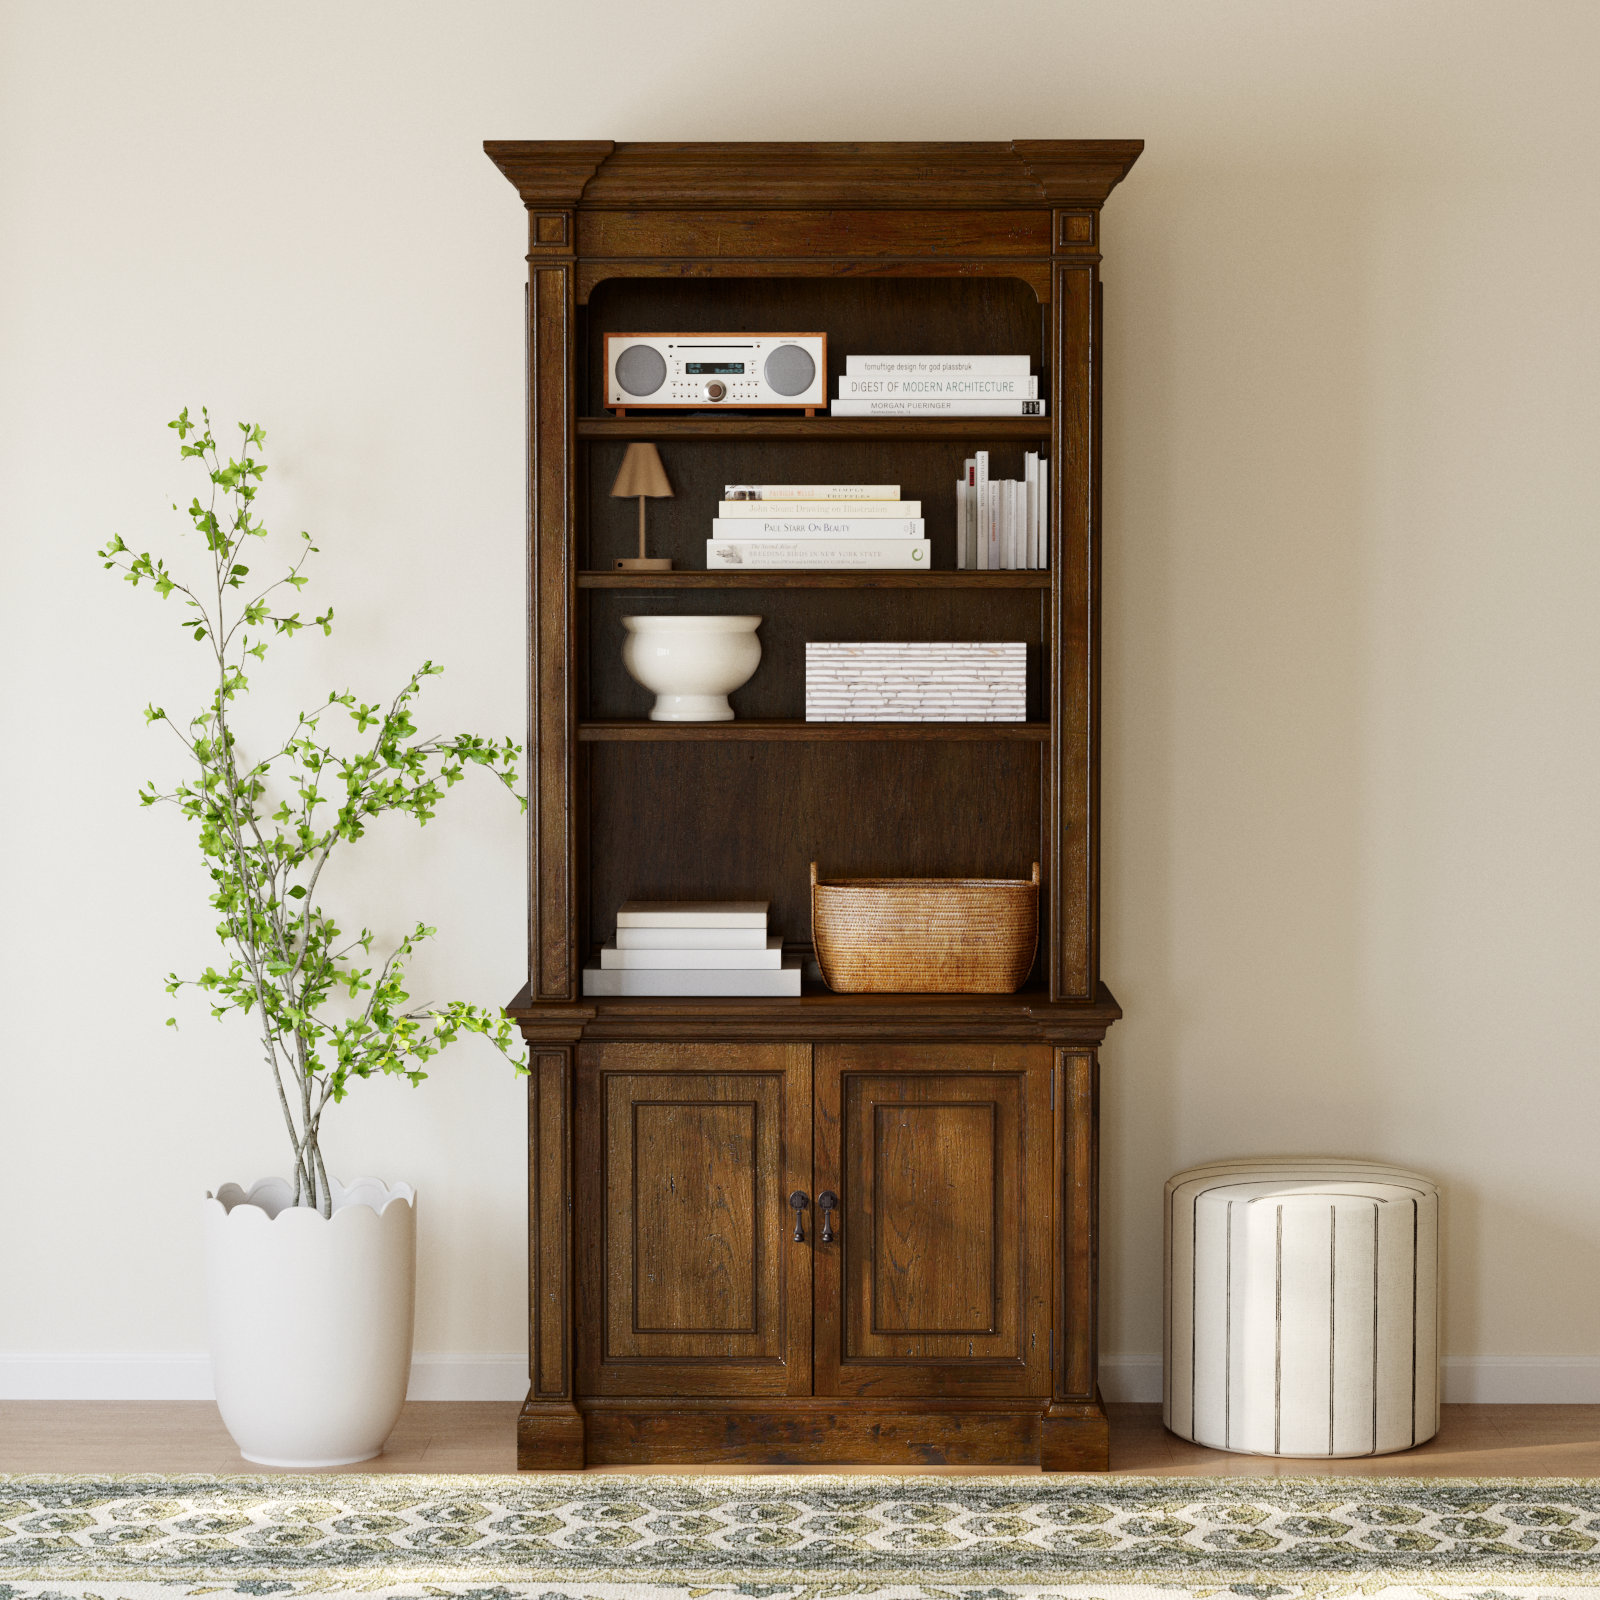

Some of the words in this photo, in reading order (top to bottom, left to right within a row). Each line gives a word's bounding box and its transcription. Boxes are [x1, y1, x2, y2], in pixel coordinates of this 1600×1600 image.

[896, 362, 917, 373] design
[918, 362, 928, 371] for
[929, 362, 941, 373] god
[851, 381, 884, 392] DIGEST
[887, 381, 899, 392] OF
[902, 381, 943, 392] MODERN
[945, 381, 1015, 392] ARCHITECTURE
[749, 504, 768, 513] John
[796, 504, 830, 515] Drawing
[843, 504, 888, 513] Illustration
